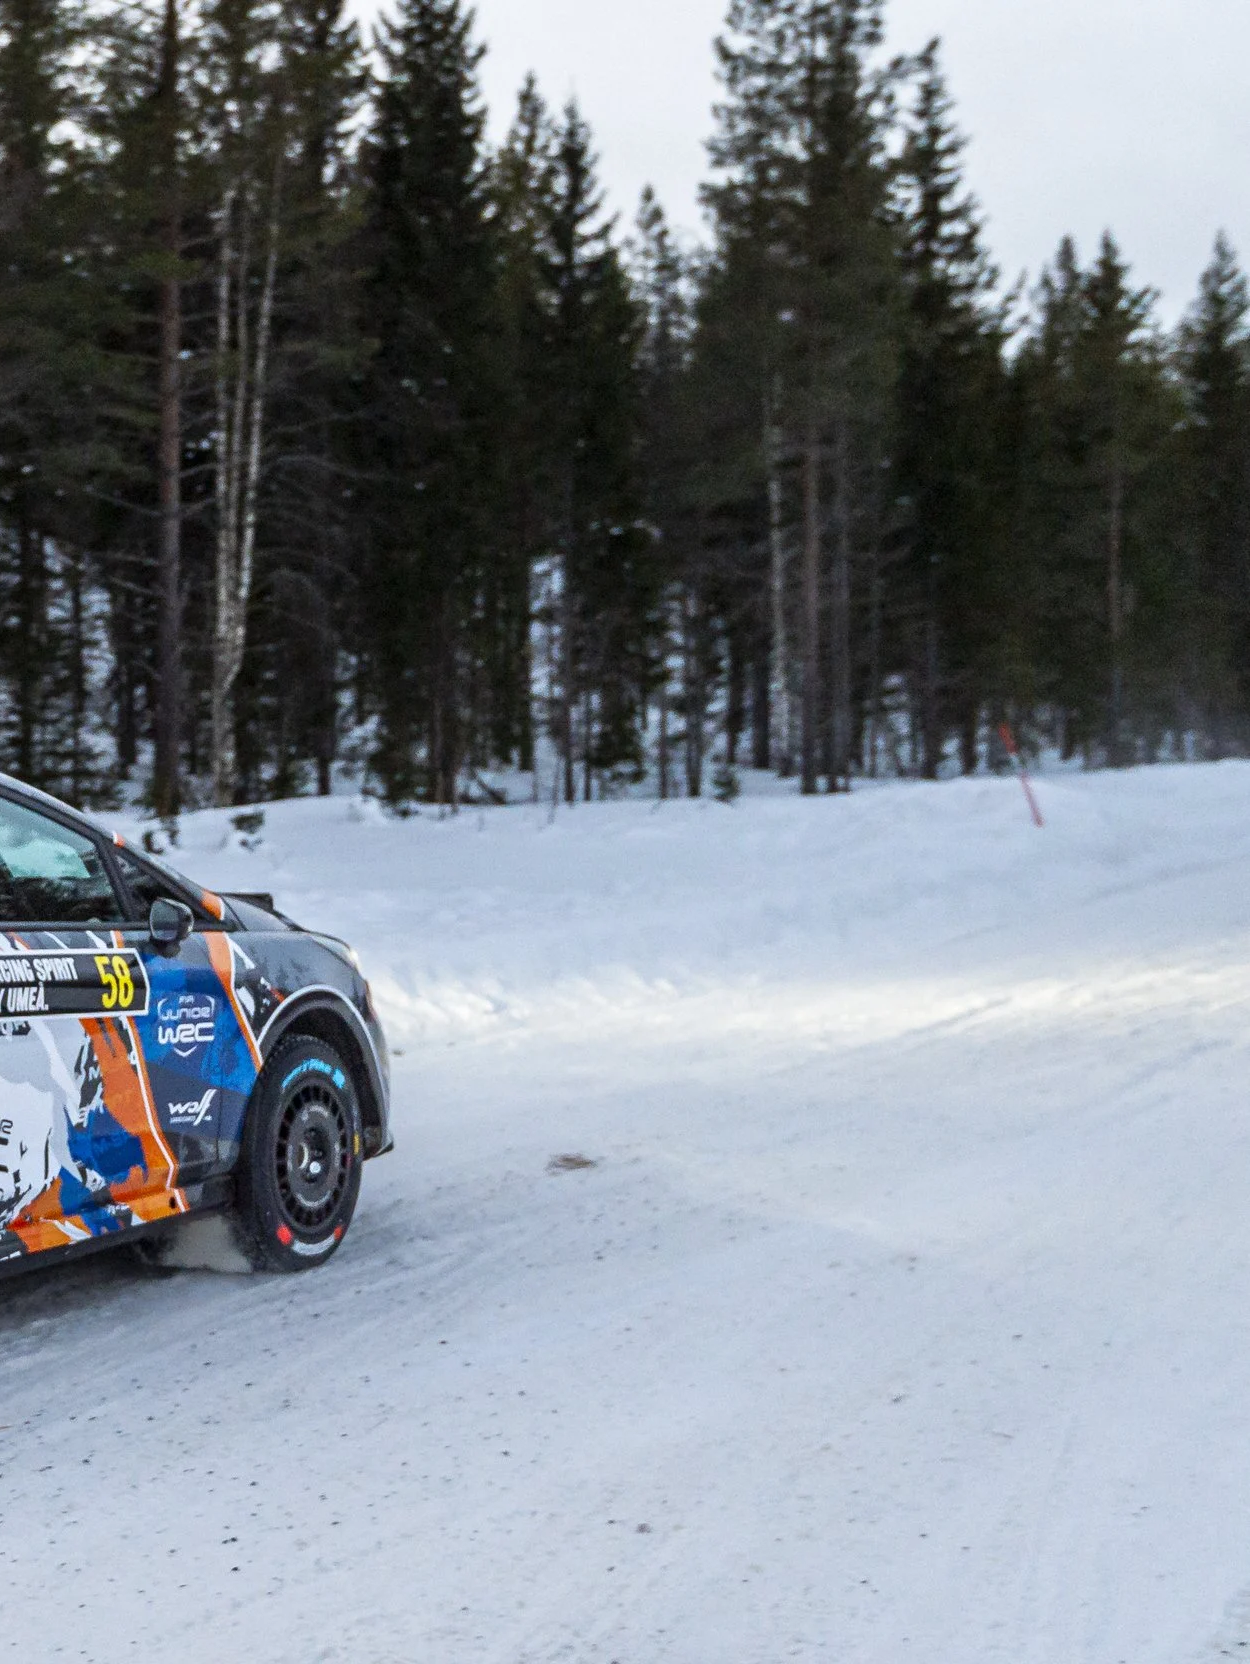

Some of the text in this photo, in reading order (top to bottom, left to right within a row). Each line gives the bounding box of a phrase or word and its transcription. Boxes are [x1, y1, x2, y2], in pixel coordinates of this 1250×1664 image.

[32, 957, 79, 982] SPIRIT
[94, 955, 135, 1009] 58
[6, 981, 49, 1012] UMEÅ.
[158, 1022, 215, 1045] WRC
